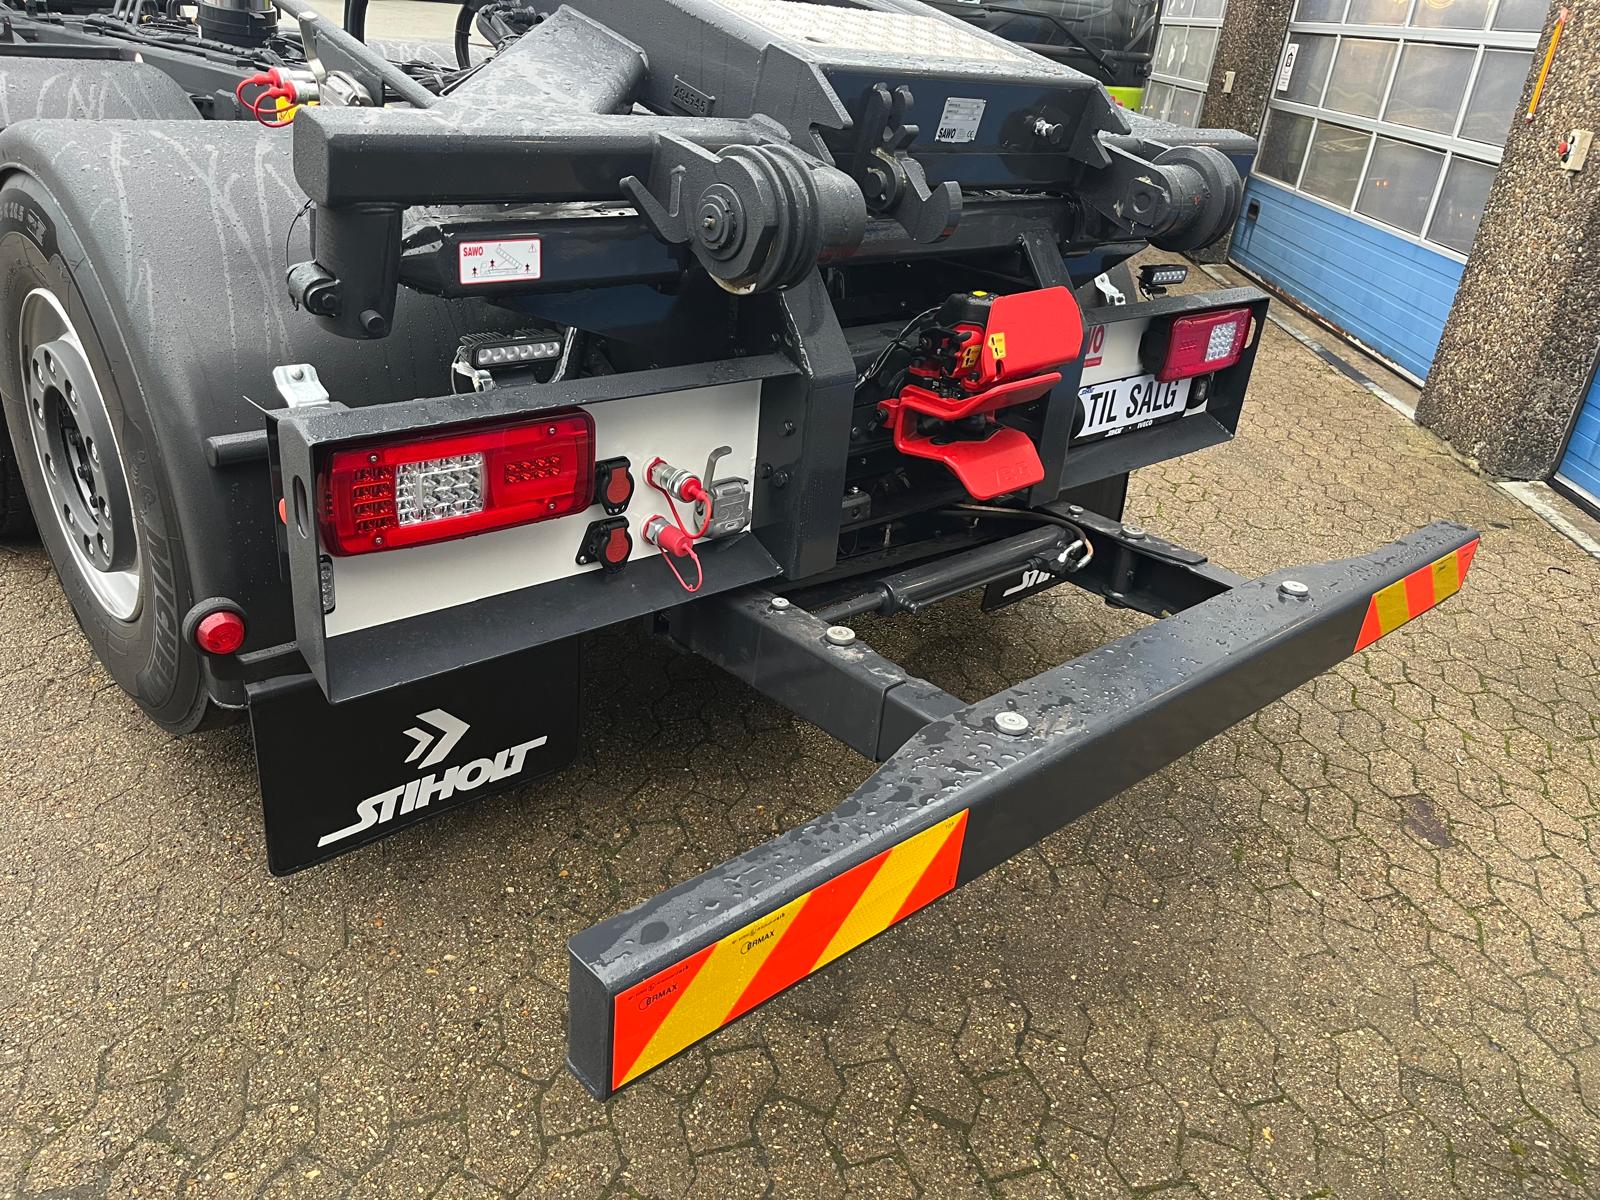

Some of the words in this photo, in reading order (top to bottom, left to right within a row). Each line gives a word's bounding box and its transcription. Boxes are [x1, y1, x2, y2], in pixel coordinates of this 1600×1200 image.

[938, 127, 957, 139] SAWO
[463, 246, 484, 257] SAWO
[1088, 389, 1117, 428] TIL
[1125, 381, 1178, 418] SALG
[1136, 420, 1153, 430] IVECO
[317, 735, 548, 847] STIHOLT
